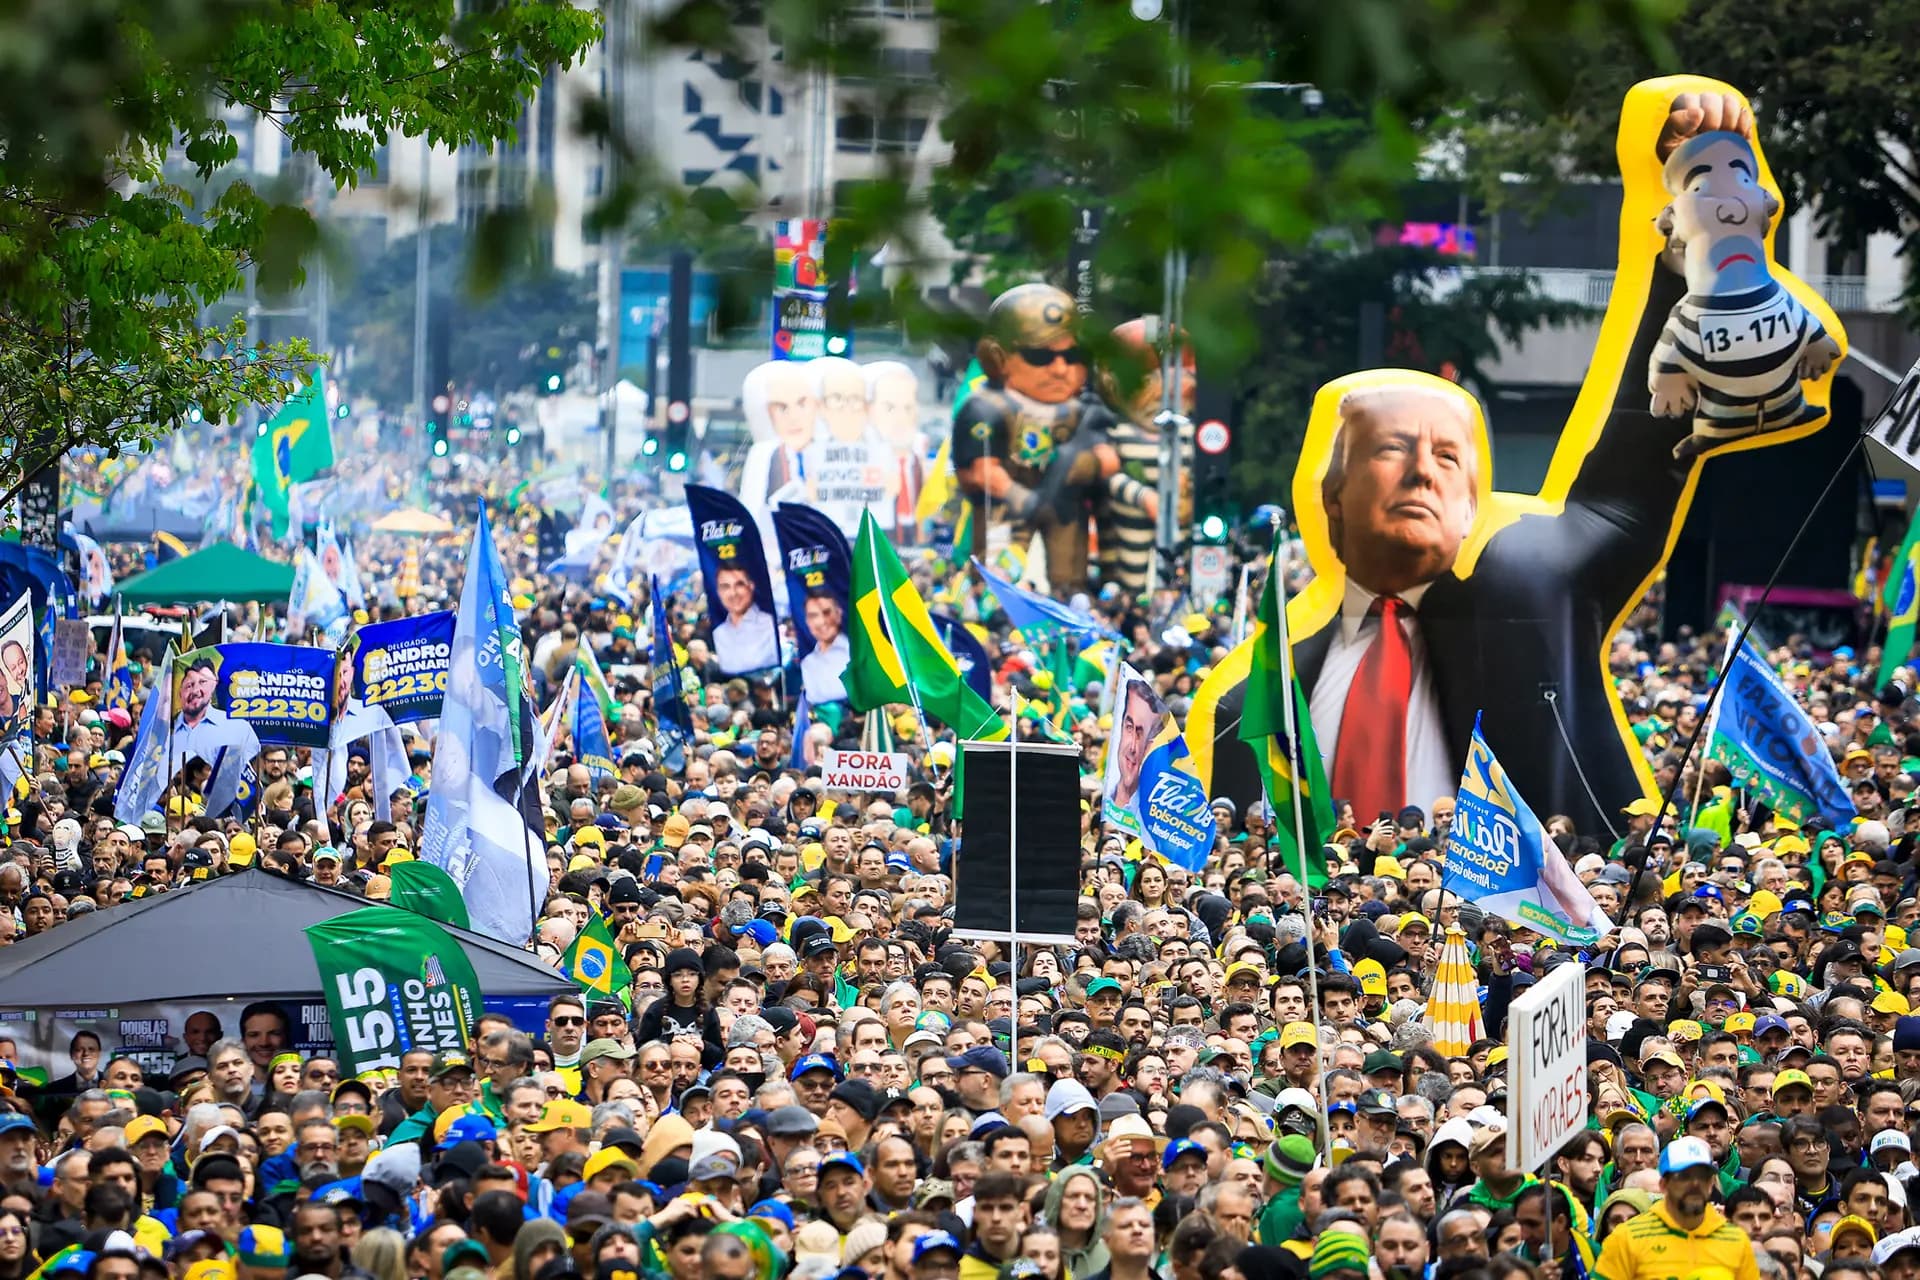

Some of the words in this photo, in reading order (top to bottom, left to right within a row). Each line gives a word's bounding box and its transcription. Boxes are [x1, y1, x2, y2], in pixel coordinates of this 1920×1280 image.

[387, 637, 428, 652] DELEGADO
[364, 670, 449, 706] 22230
[229, 698, 327, 723] 22230
[837, 753, 893, 771] FORA
[826, 771, 902, 790] XANDÃO
[1149, 803, 1208, 842] Bolsonaro
[301, 1005, 331, 1025] RUB
[120, 1020, 167, 1035] DOUGLAS
[1533, 1064, 1583, 1159] MORAES
